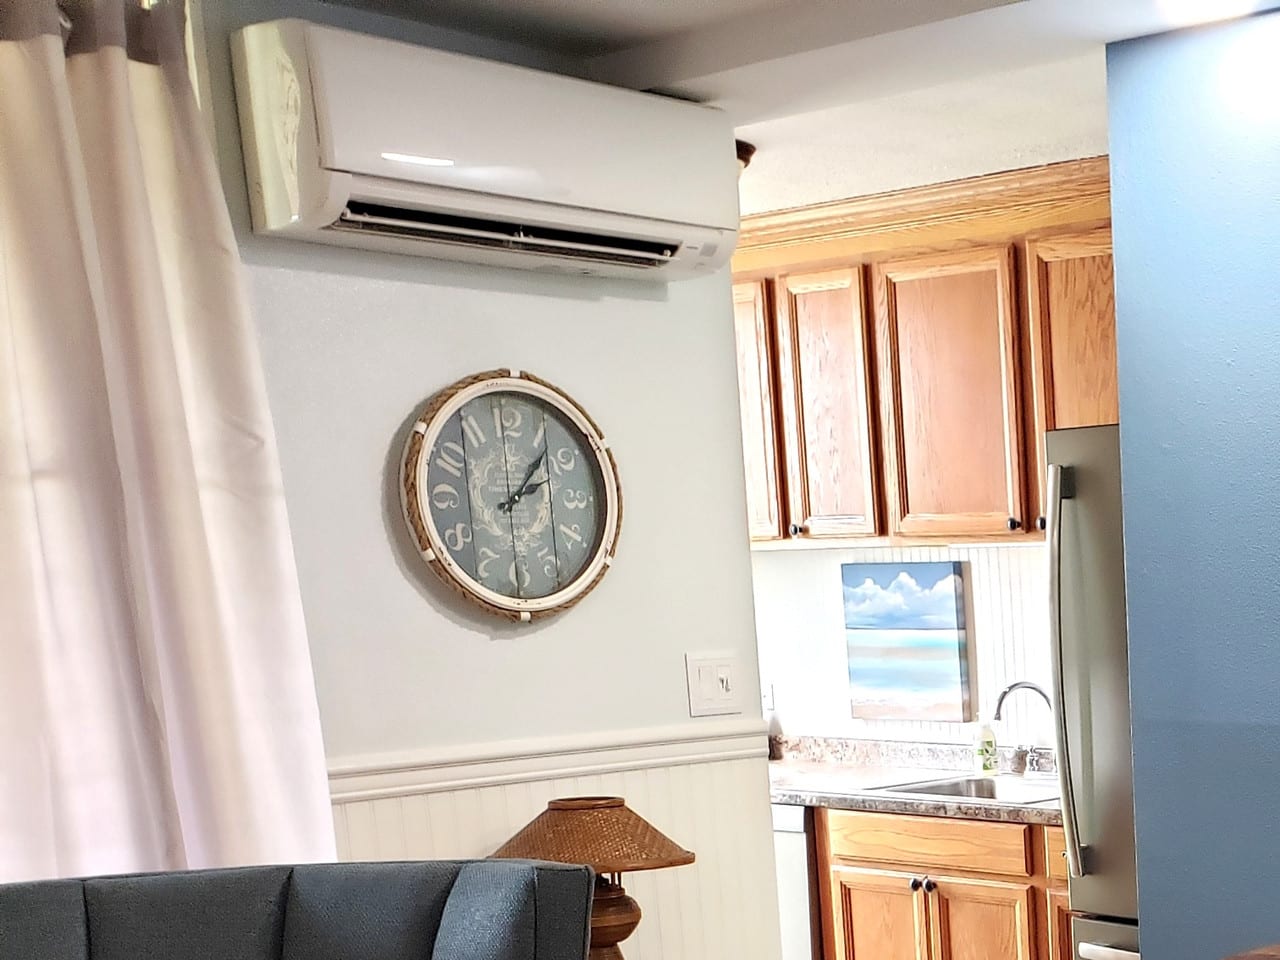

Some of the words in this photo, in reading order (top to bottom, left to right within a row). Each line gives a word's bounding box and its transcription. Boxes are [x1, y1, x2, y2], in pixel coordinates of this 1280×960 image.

[461, 415, 486, 448] 11
[492, 406, 522, 438] 12
[436, 441, 465, 477] 10
[550, 448, 576, 475] 2
[562, 489, 588, 510] 3
[445, 523, 473, 551] 8
[558, 523, 583, 550] 4
